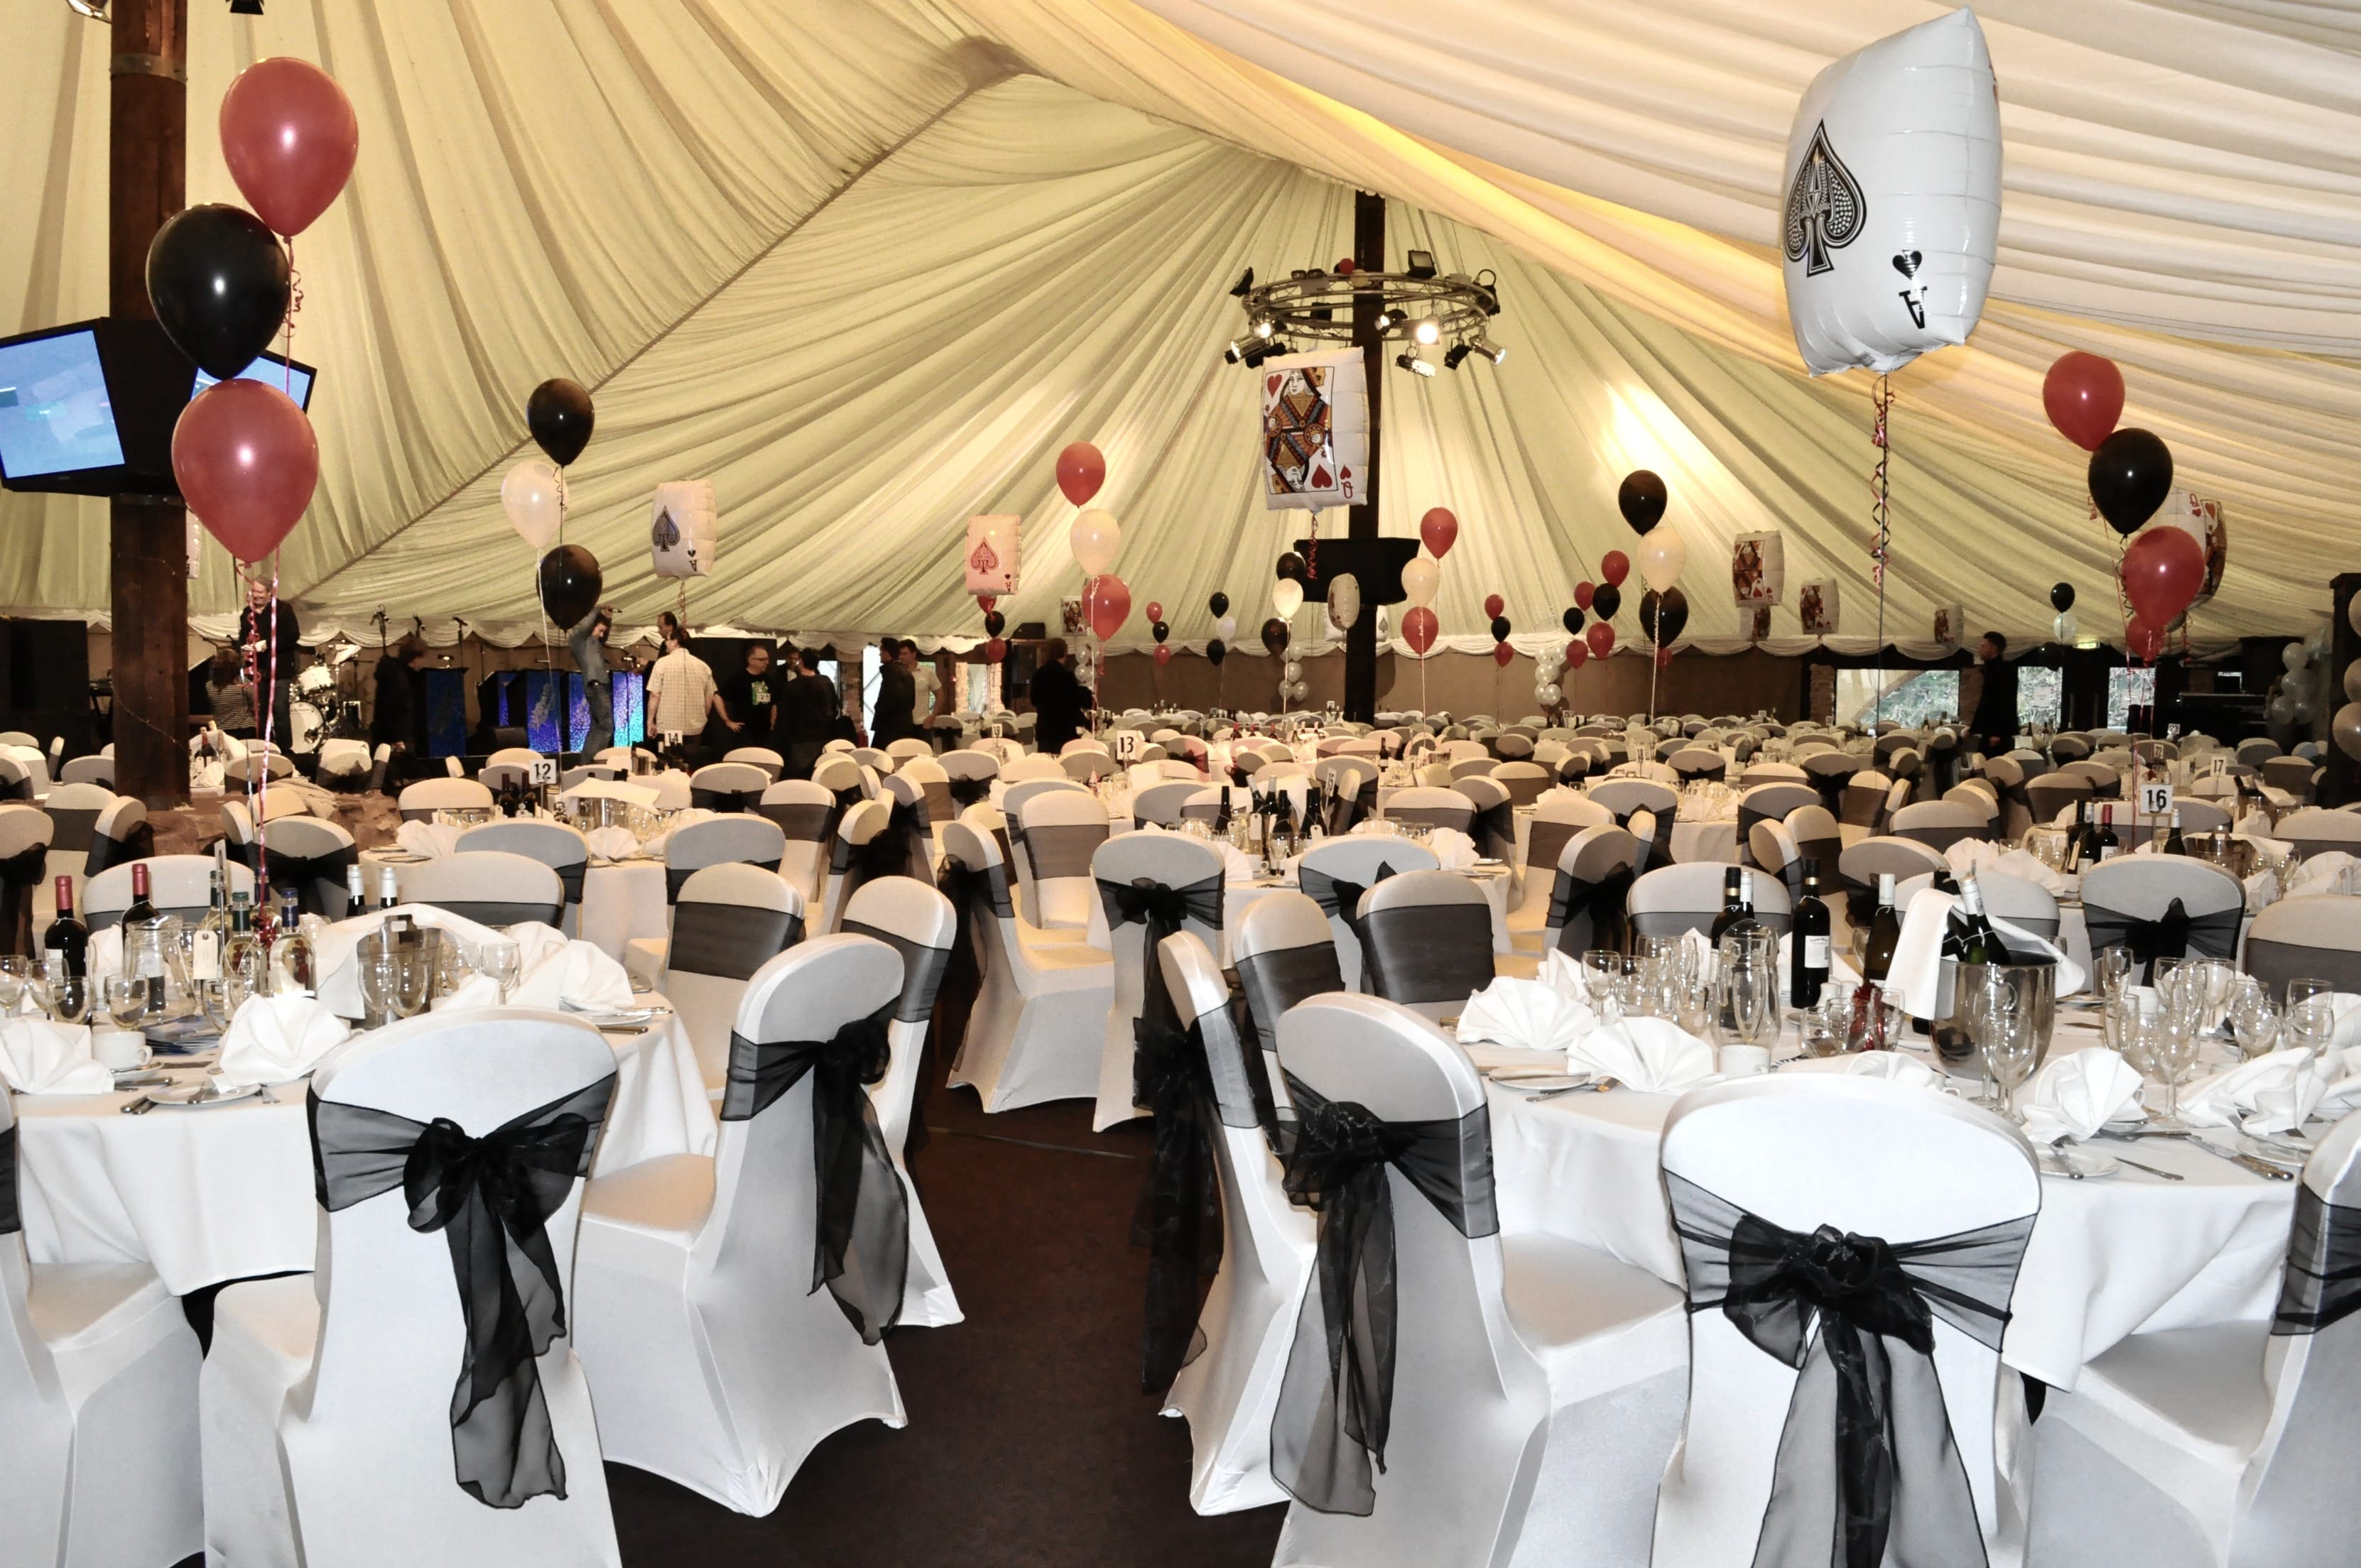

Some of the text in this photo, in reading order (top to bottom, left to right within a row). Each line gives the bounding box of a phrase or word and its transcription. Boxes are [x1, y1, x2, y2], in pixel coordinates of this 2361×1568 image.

[1899, 286, 1928, 329] A
[1341, 481, 1353, 499] Q
[2190, 494, 2200, 507] Q
[688, 560, 698, 572] A
[1005, 582, 1011, 592] A
[668, 733, 679, 744] 14
[1119, 736, 1134, 753] 13
[534, 763, 552, 780] 12
[2213, 759, 2224, 773] 17
[1327, 772, 1335, 792] 15
[2146, 789, 2167, 811] 16
